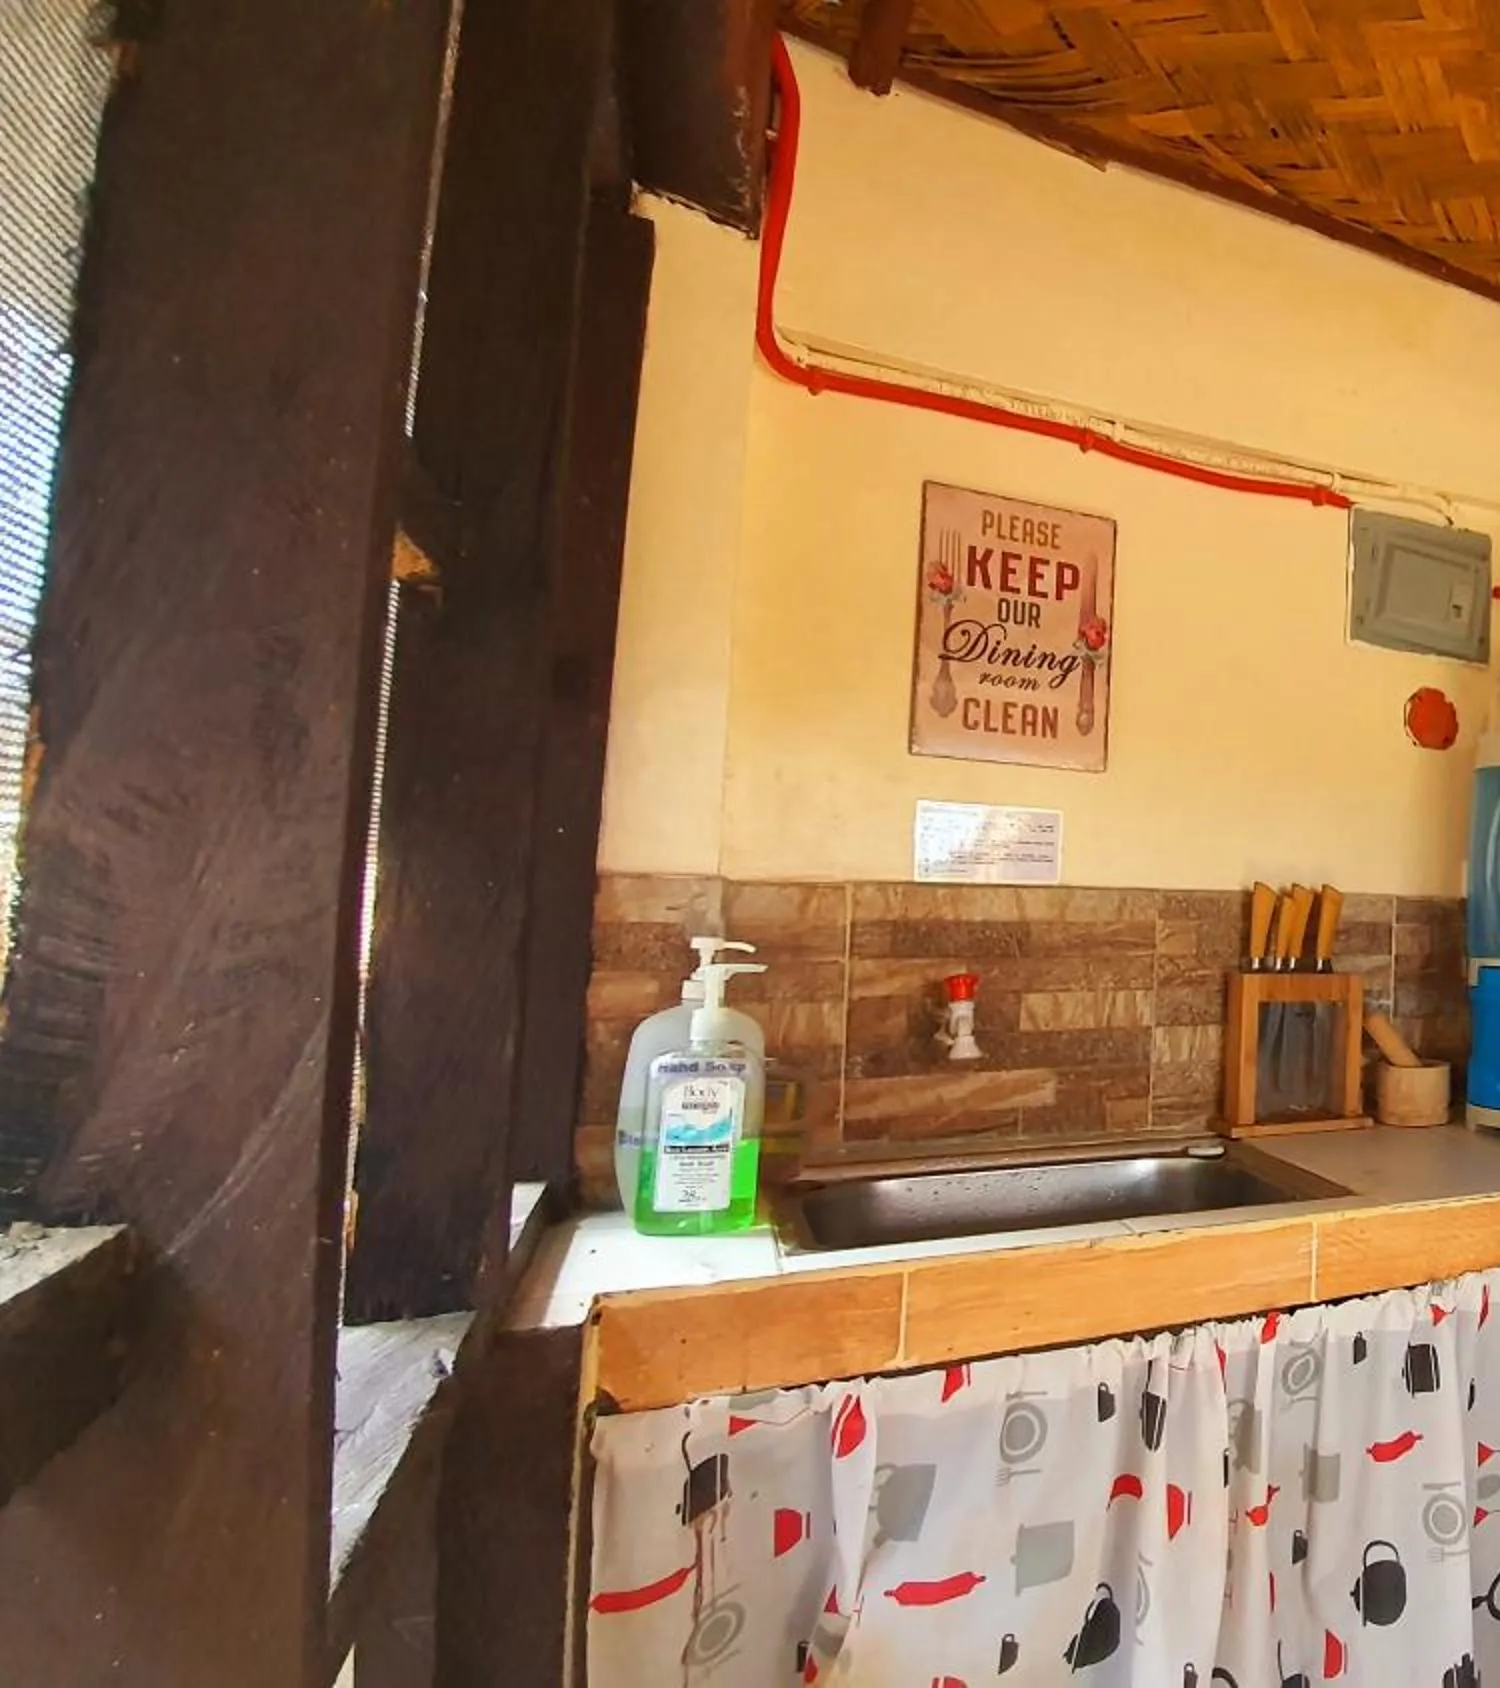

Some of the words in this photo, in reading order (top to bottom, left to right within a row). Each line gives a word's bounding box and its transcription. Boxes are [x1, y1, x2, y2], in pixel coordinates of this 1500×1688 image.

[981, 510, 1061, 549] PLEASE
[966, 545, 1080, 601] KEEP
[997, 598, 1041, 628] OUR
[939, 619, 1081, 689] Dining
[978, 671, 1041, 691] room
[961, 697, 1059, 739] CLEAN
